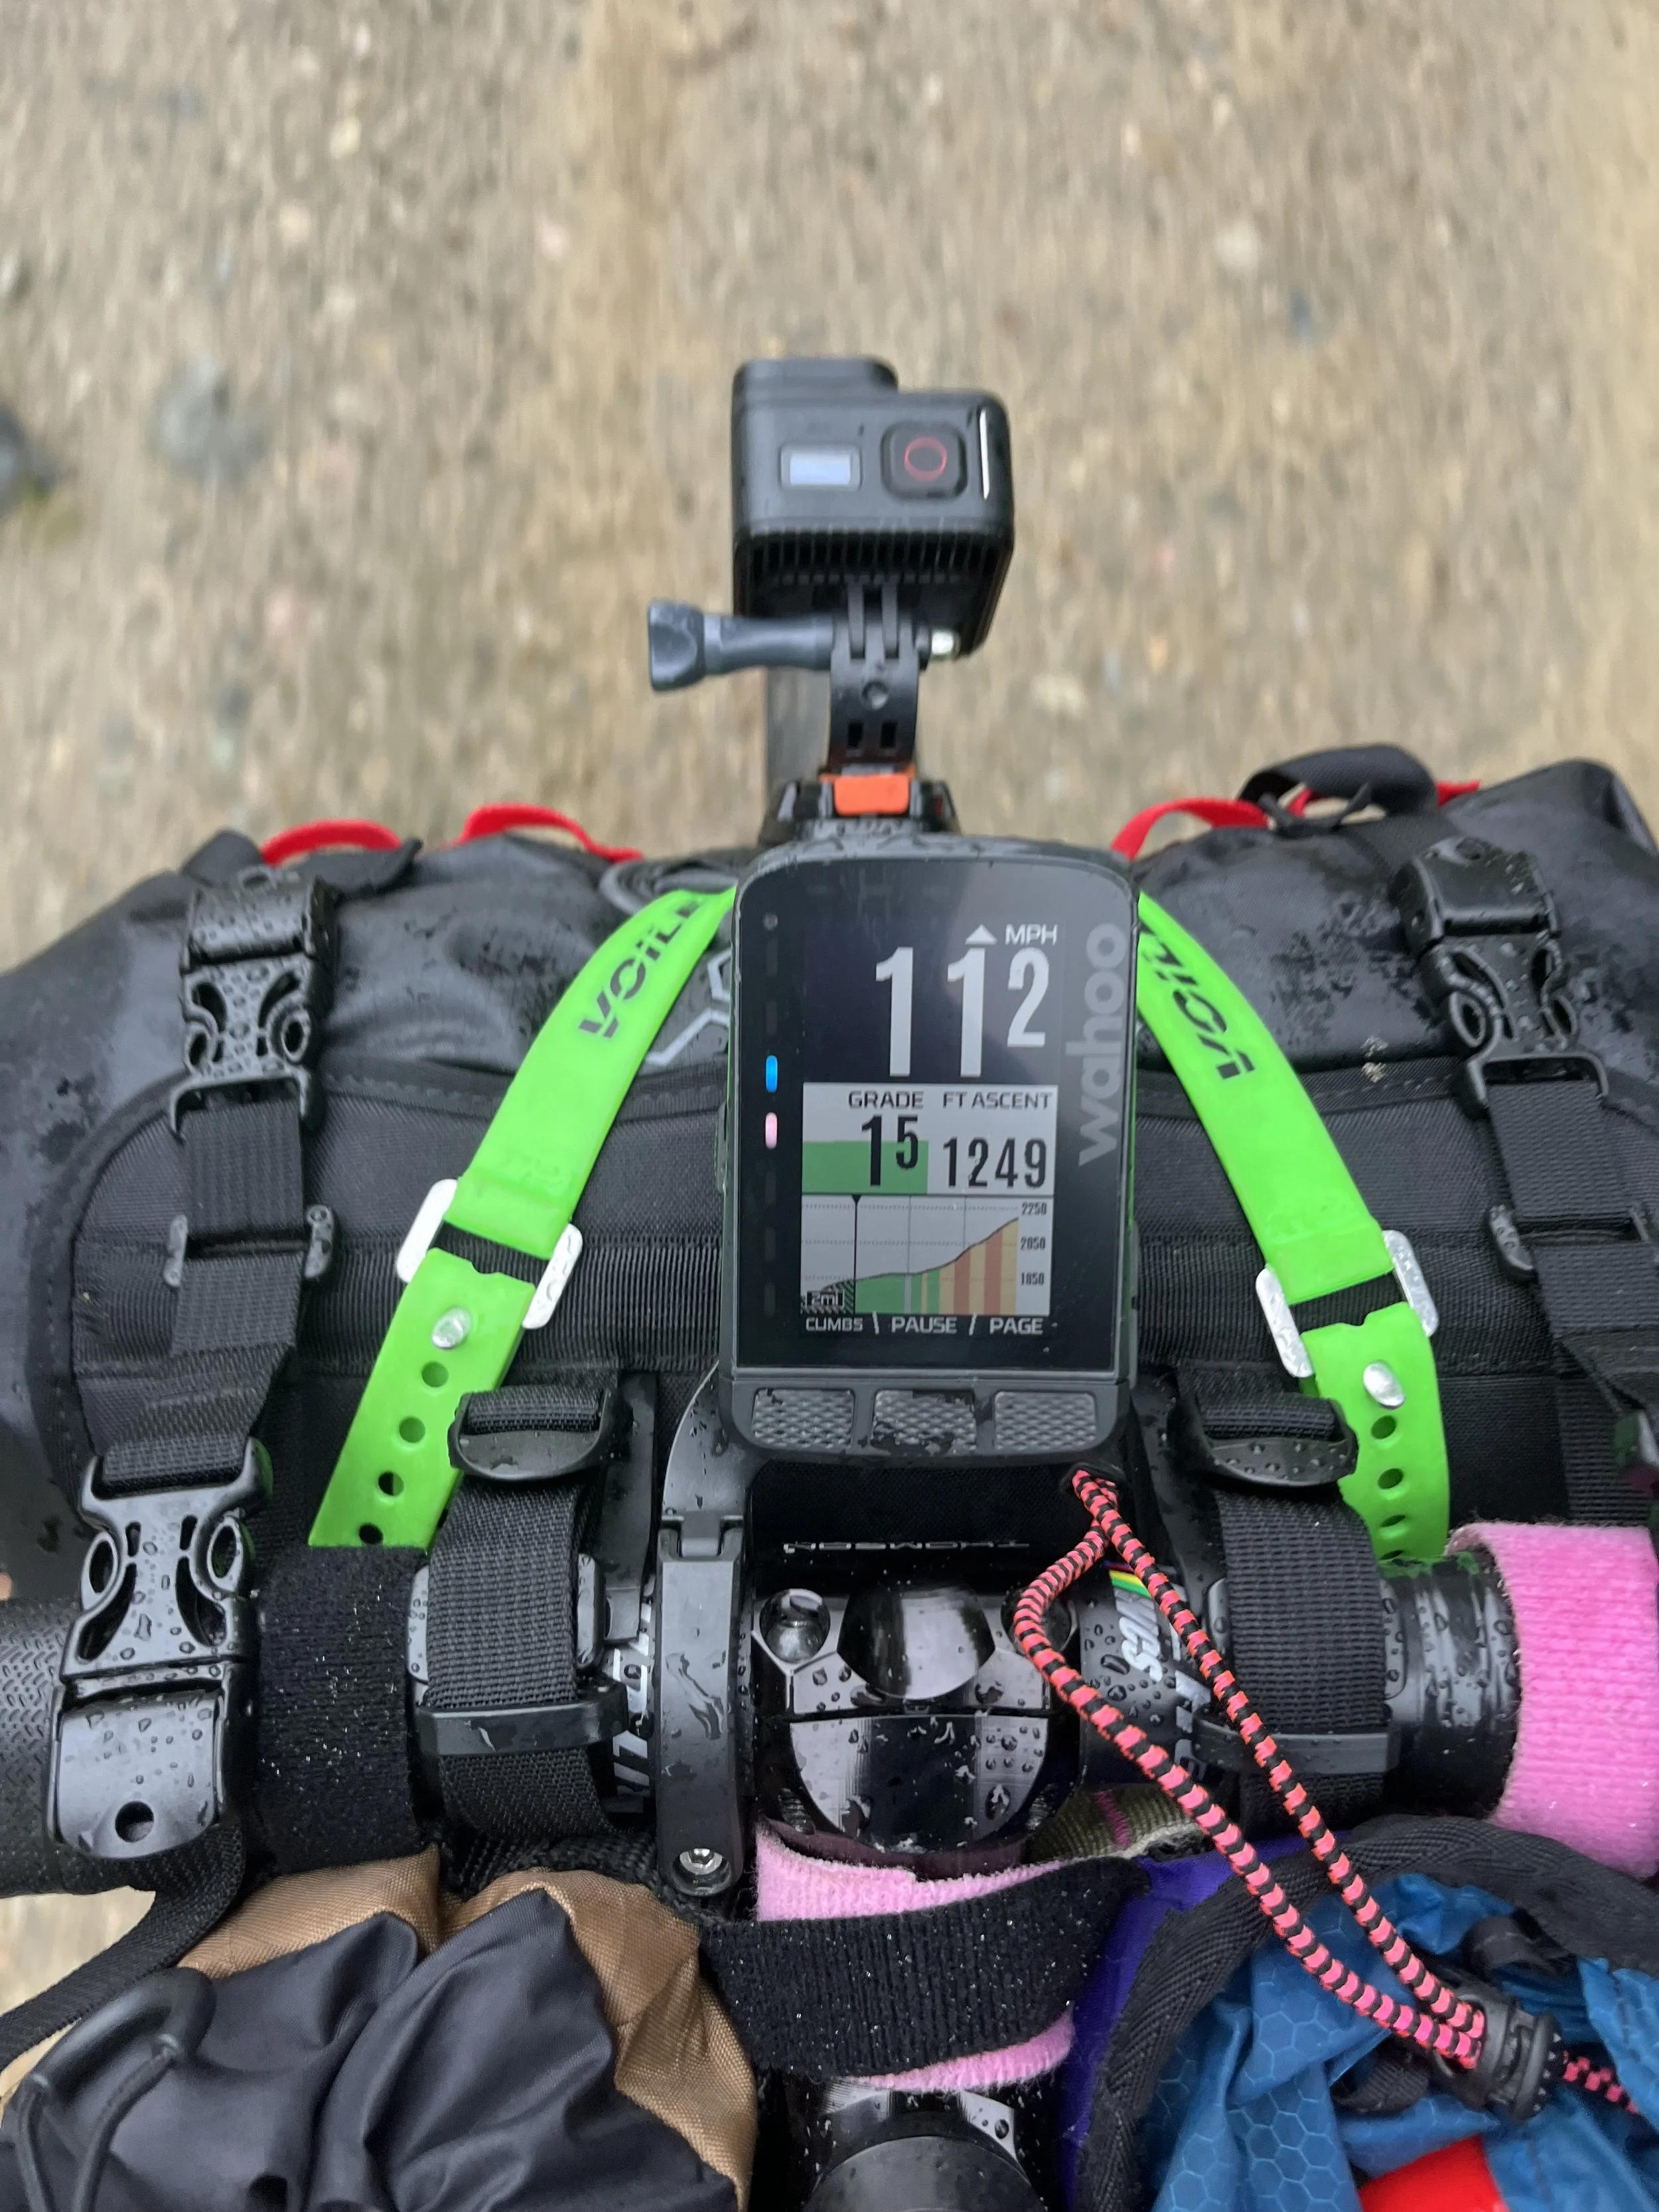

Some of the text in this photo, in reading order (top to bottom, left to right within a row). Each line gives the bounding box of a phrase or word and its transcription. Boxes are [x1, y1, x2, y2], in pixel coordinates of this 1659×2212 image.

[1005, 923, 1058, 946] MPH
[1065, 922, 1127, 1167] wahoo
[848, 1090, 924, 1110] GRADE
[942, 1091, 1053, 1110] FT ASCENT
[942, 1136, 1047, 1189] 1249
[1021, 1201, 1048, 1216] 2250
[805, 1316, 1044, 1335] CLIMBS PAUSE PAGE
